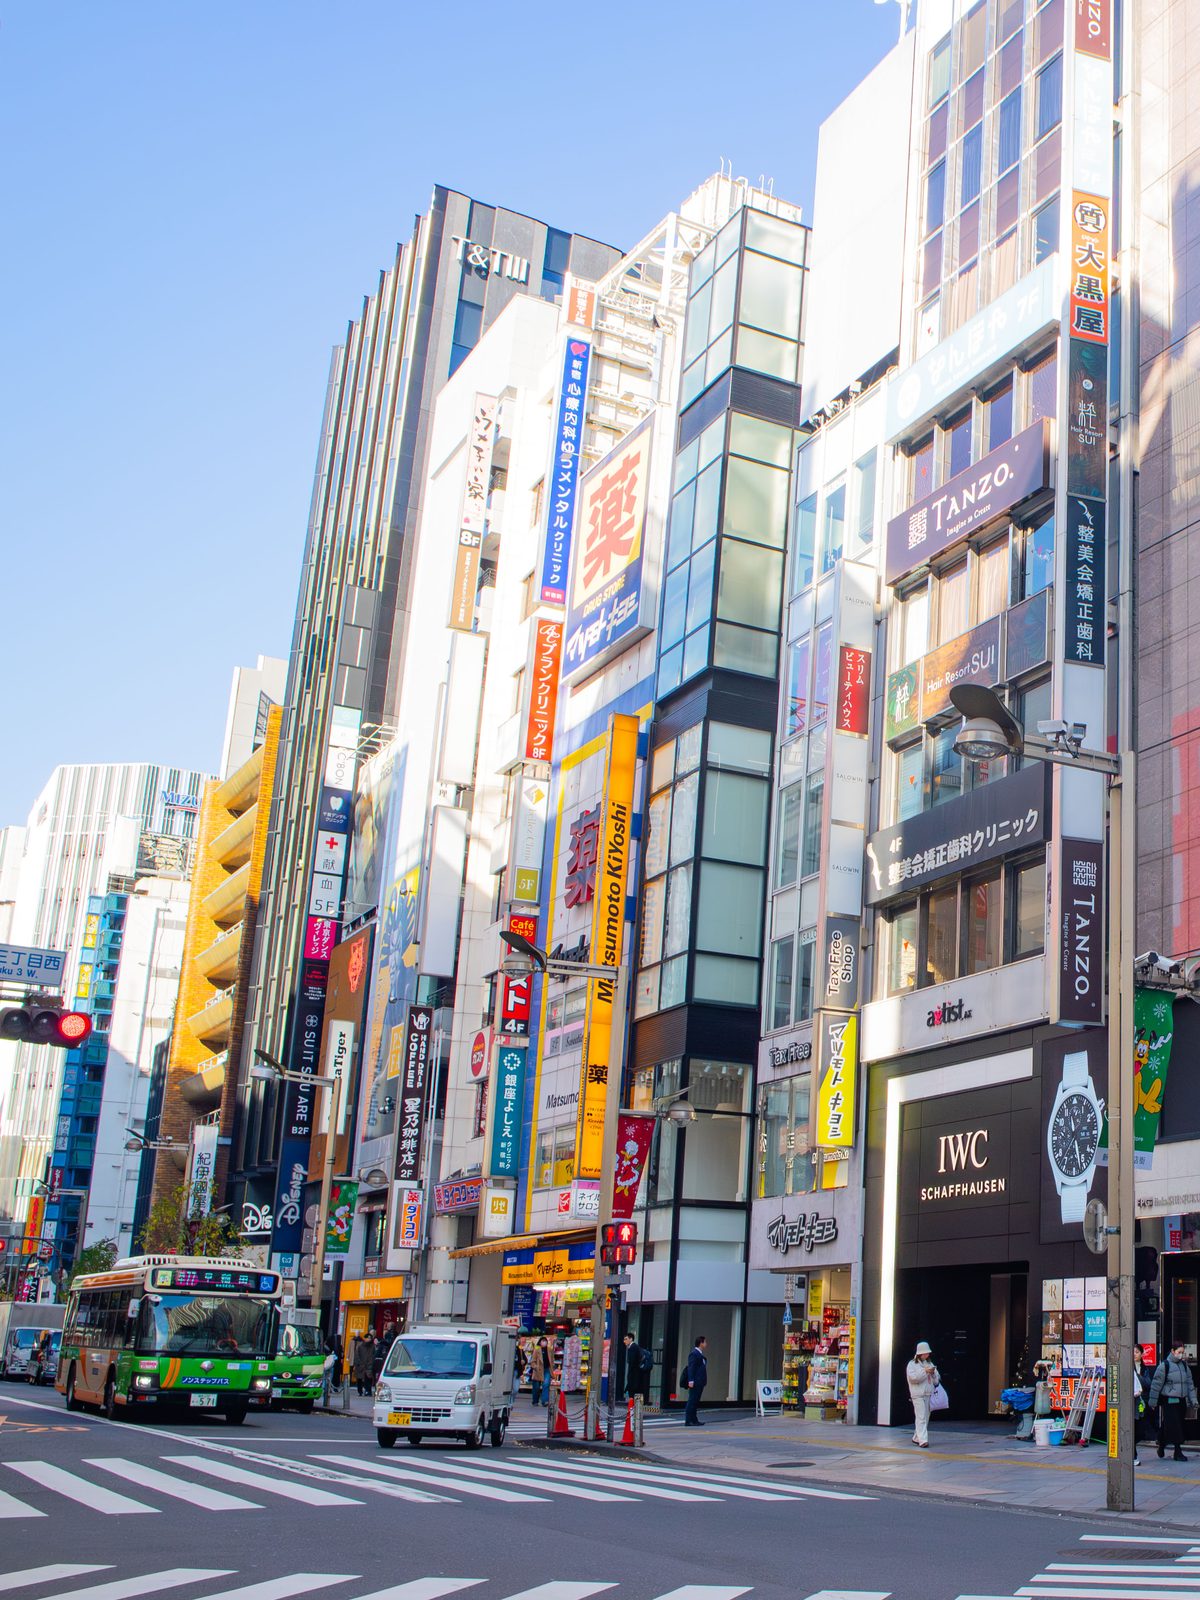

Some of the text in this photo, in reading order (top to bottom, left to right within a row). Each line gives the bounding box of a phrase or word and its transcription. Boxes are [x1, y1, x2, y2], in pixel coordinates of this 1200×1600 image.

[1079, 206, 1103, 231] 質
[1074, 243, 1105, 336] 大黒屋
[1078, 433, 1097, 446] SUI
[931, 461, 1014, 532] TANZO.
[460, 530, 481, 547] 8F
[1075, 526, 1095, 661] 整美会矯正歯科
[855, 652, 867, 686] スリム
[926, 646, 996, 695] Hair Resort SUI
[841, 651, 855, 729] ビューティハウス
[532, 748, 547, 759] 8F
[835, 772, 864, 783] SALOWIN
[606, 802, 628, 880] KiYoshi
[887, 808, 1040, 887] 整美会矯正歯科クリニック
[889, 836, 903, 853] 4F
[831, 863, 860, 874] SALOWIN
[518, 879, 535, 891] 5F
[314, 898, 335, 912] 5F
[510, 919, 534, 931] Café
[597, 881, 620, 1004] Matsumoto
[1072, 892, 1096, 1001] TANZO.
[0, 949, 61, 970] 三丁目西
[16, 967, 23, 976] 3
[827, 930, 843, 996] Tax Free
[841, 944, 855, 984] Shop
[504, 1019, 525, 1033] 4F
[406, 1033, 419, 1088] COFFEE
[416, 1034, 428, 1088] HAND DRIP
[769, 1040, 812, 1067] Tax Free
[295, 1031, 316, 1122] SUIT SUARE
[588, 1064, 609, 1086] 薬
[826, 1021, 849, 1139] マツモトキヨシ
[502, 1074, 517, 1138] 銀座よしえ
[291, 1126, 310, 1135] B2F
[938, 1129, 989, 1173] IWC
[400, 1169, 414, 1179] 2F
[920, 1177, 1007, 1201] SCHAFFHAUSEN
[407, 1190, 420, 1203] 薬
[241, 1202, 273, 1232] Dis
[405, 1205, 418, 1240] ダイコク
[767, 1212, 839, 1254] マツモトキヨシ
[182, 1377, 230, 1385] ノンステップバス
